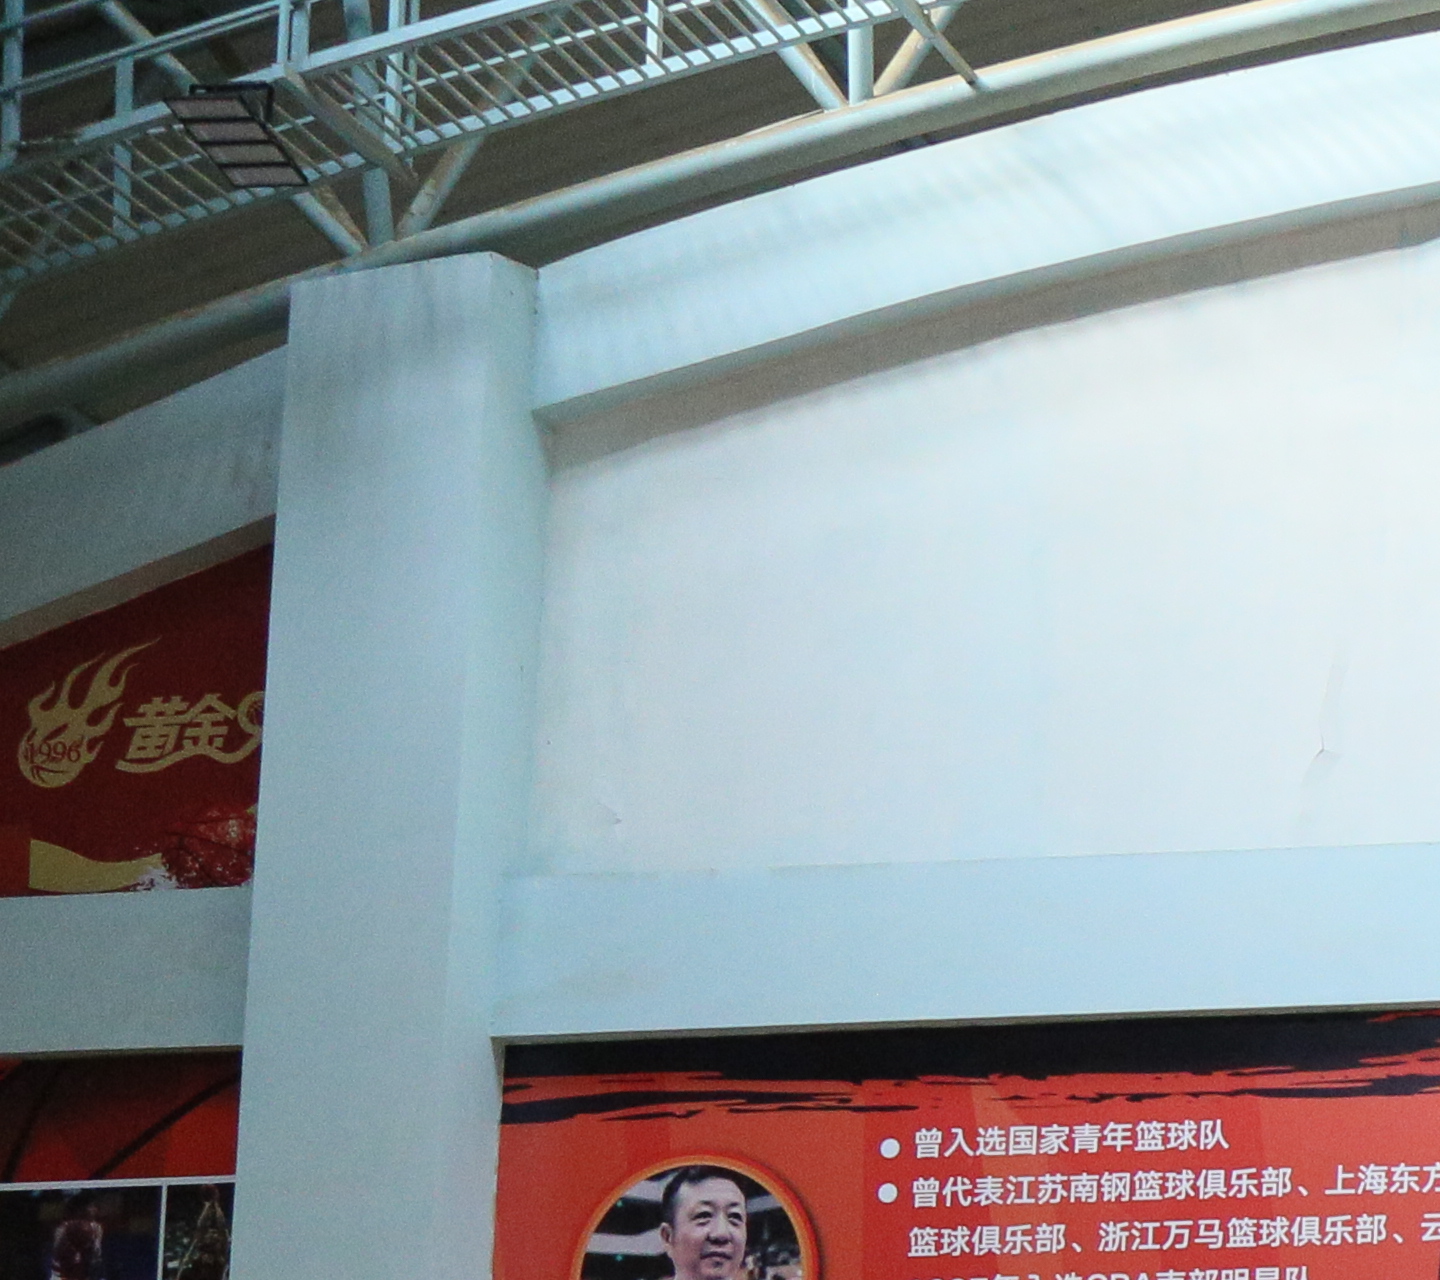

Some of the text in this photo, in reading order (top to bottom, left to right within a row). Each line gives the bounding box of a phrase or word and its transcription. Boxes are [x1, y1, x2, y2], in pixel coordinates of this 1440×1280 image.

[914, 1119, 1229, 1159] 曾入选国家青年篮球队
